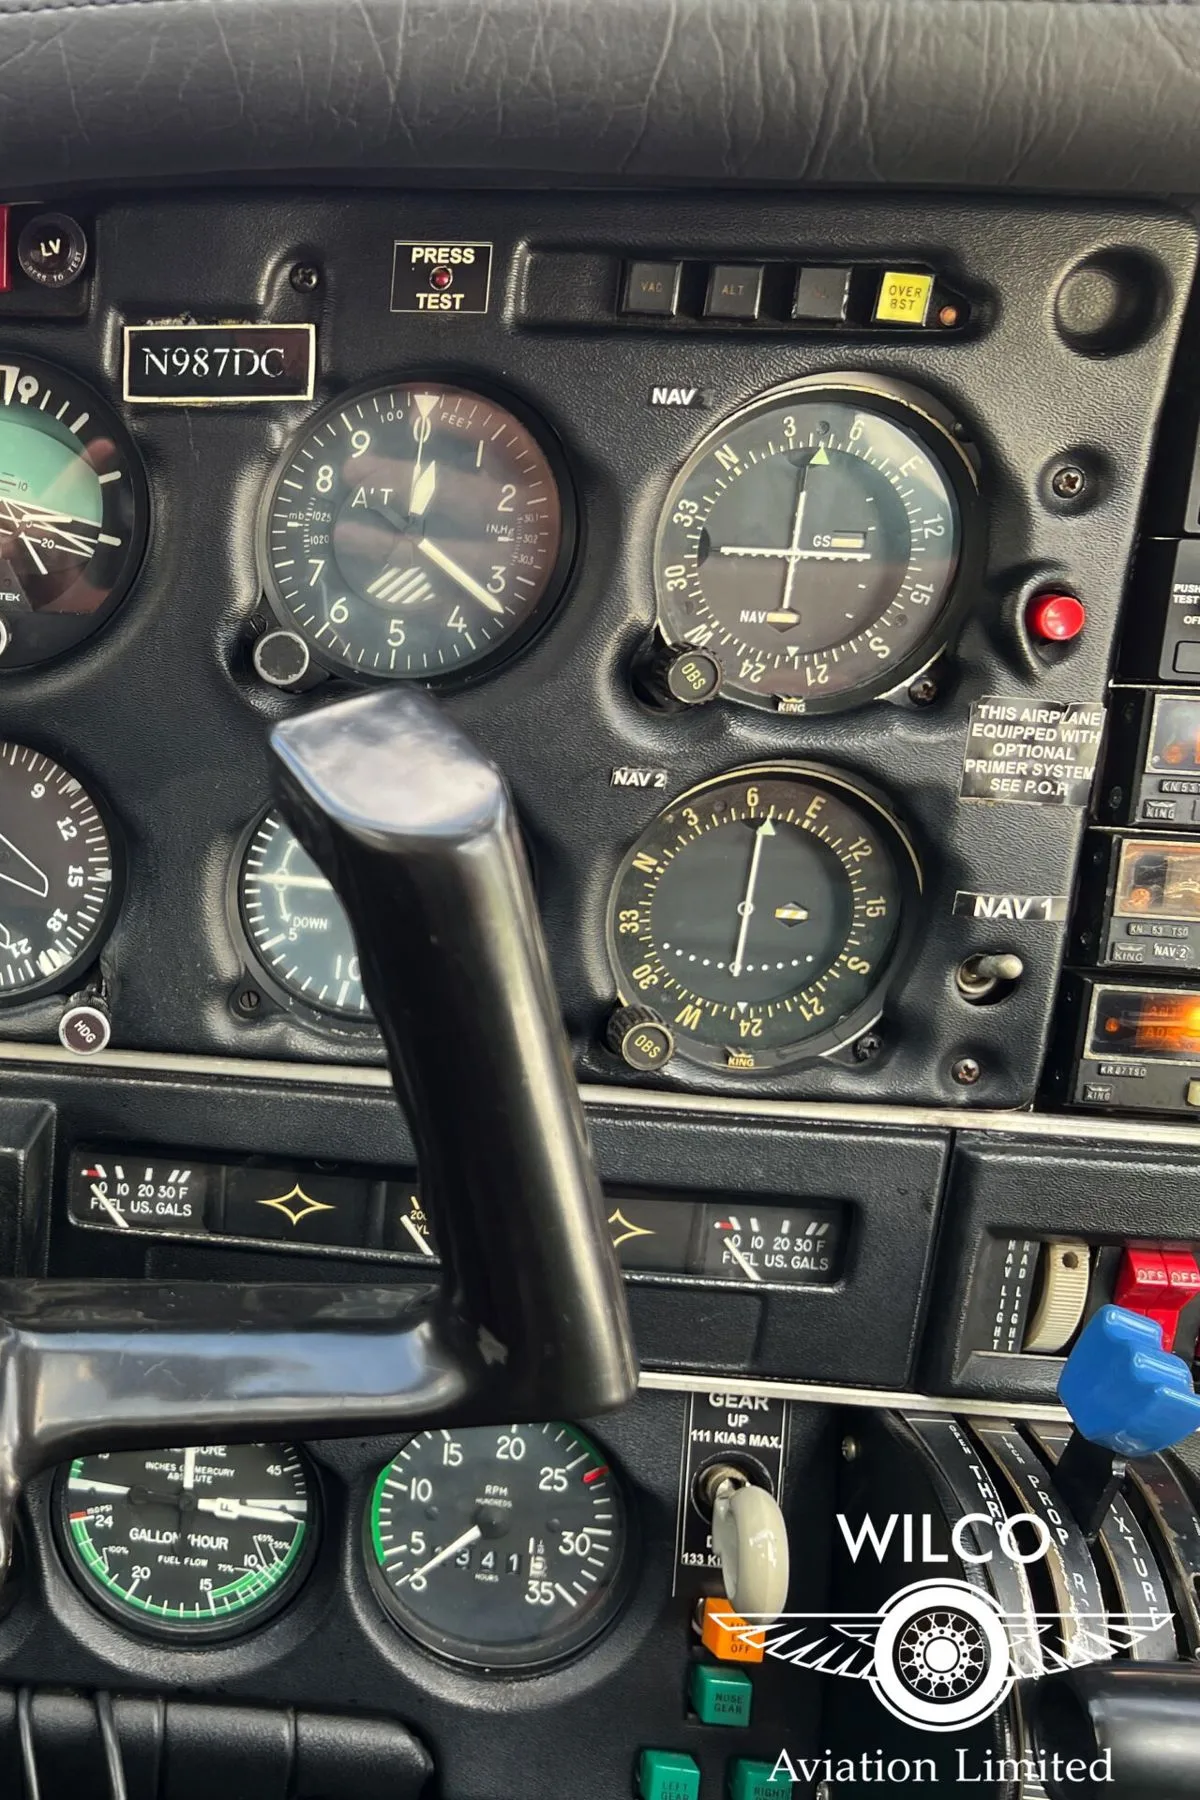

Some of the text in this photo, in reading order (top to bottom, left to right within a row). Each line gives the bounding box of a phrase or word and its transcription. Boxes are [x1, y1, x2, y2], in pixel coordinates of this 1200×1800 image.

[40, 238, 61, 257] LV
[411, 247, 475, 264] PRESS
[53, 251, 82, 282] TO TEST
[722, 284, 744, 296] ALT
[888, 284, 922, 298] OVER
[416, 293, 464, 310] TEST
[142, 347, 285, 378] N987DC
[651, 388, 697, 405] NAV
[440, 413, 473, 430] FEET
[813, 535, 831, 547] GS
[1173, 594, 1199, 604] TEST
[739, 610, 766, 623] NAV
[681, 662, 706, 691] OBS
[777, 702, 805, 713] KING
[978, 705, 1016, 721] THIS
[972, 723, 1101, 744] EQUIPPED WITH
[993, 743, 1076, 761] OPTIONAL
[965, 759, 1095, 780] PRIMER SYSTEM
[613, 771, 666, 788] NAV 2
[990, 778, 1021, 792] SEE
[974, 896, 1053, 919] NAV 1
[293, 917, 328, 930] DOWN
[288, 928, 298, 941] 5
[1114, 951, 1144, 962] KING
[73, 1019, 96, 1043] HDG
[634, 1034, 661, 1058] OBS
[728, 1056, 754, 1067] KING
[155, 1202, 192, 1217] GALS
[773, 1237, 813, 1252] 20 30
[791, 1255, 829, 1270] GALS
[1137, 1269, 1165, 1281] OFF
[1171, 1271, 1199, 1283] OFF
[1008, 1241, 1031, 1351] RAD LIGHT
[993, 1285, 1007, 1350] LIGHT
[709, 1392, 769, 1411] GEAR
[727, 1413, 749, 1428] UP
[691, 1430, 782, 1449] 111 KIAS MAX.
[443, 1442, 464, 1466] 15
[496, 1436, 526, 1460] 20
[145, 1461, 176, 1472] INCHES
[266, 1465, 281, 1476] 45
[539, 1467, 568, 1492] 25
[410, 1478, 433, 1501] 10
[485, 1484, 508, 1496] RPM
[475, 1498, 512, 1508] HUNDREDS
[1027, 1474, 1068, 1546] PROP
[95, 1515, 114, 1528] 24
[410, 1532, 426, 1554] 5
[558, 1532, 591, 1556] 30
[158, 1555, 208, 1567] FUEL FLOW
[683, 1553, 703, 1564] 133
[131, 1566, 151, 1579] 20
[475, 1573, 499, 1582] HOURS
[200, 1578, 213, 1591] 15
[525, 1581, 556, 1605] 35
[715, 1693, 744, 1704] NOSE
[714, 1703, 742, 1714] GEAR
[662, 1781, 688, 1791] LEFT
[754, 1787, 786, 1797] RIGHT
